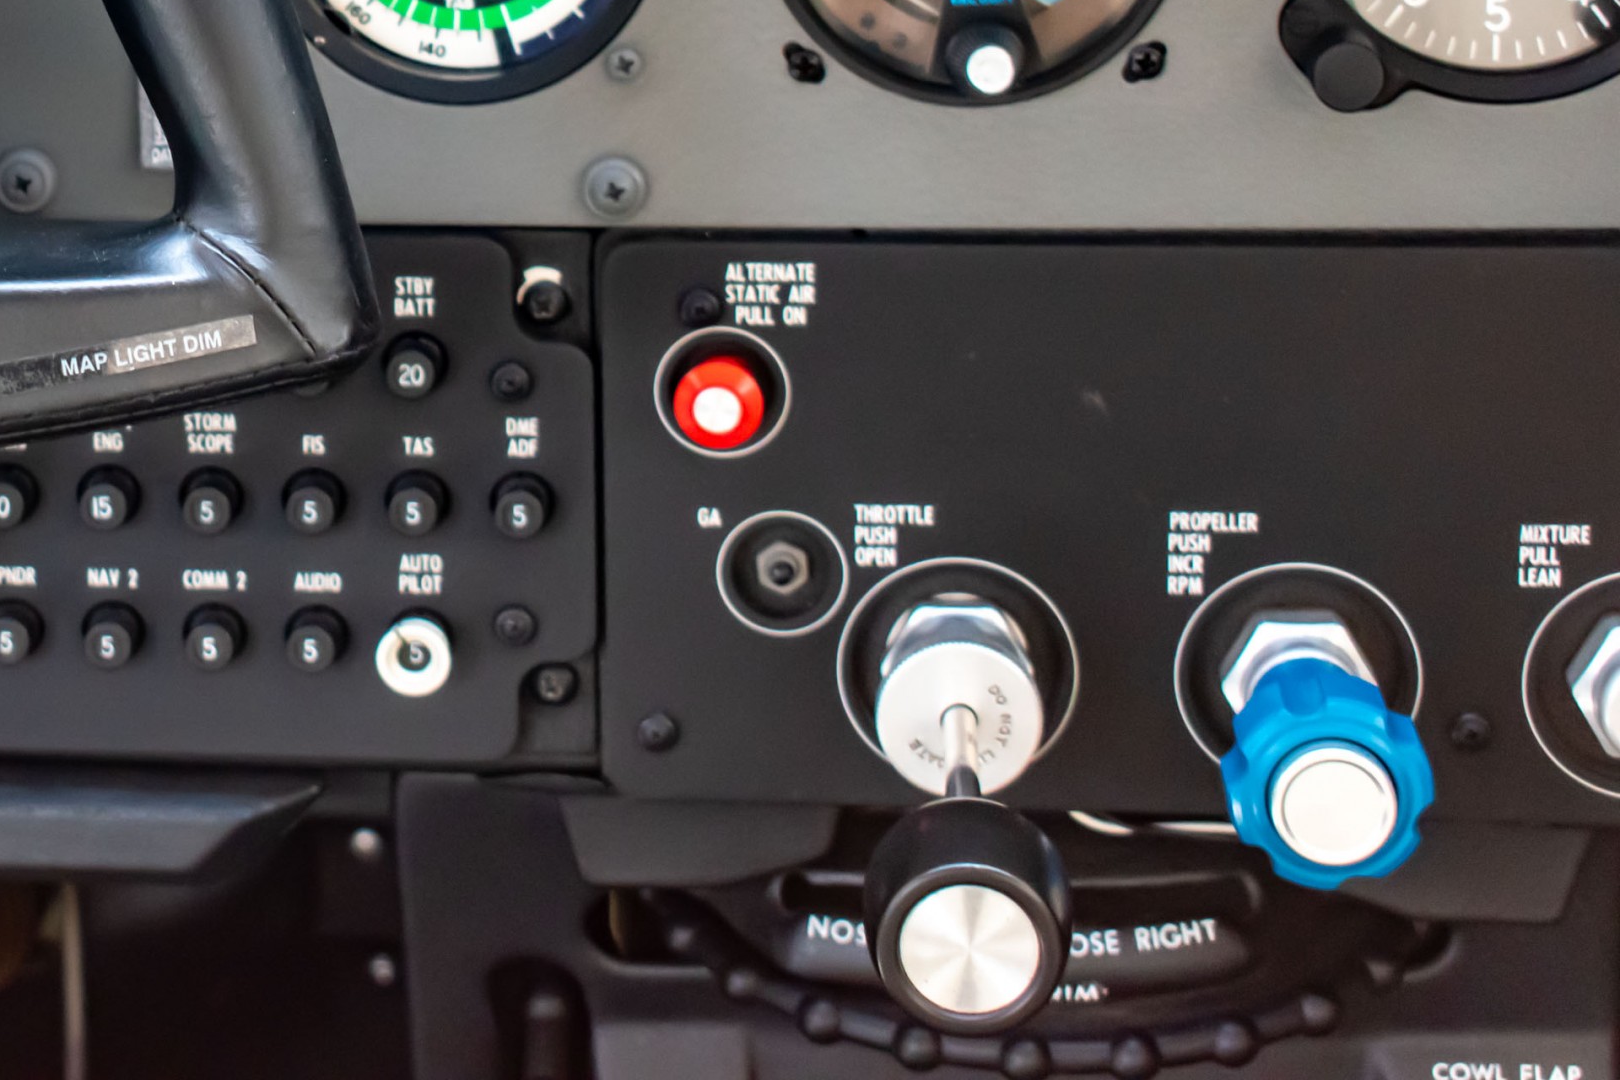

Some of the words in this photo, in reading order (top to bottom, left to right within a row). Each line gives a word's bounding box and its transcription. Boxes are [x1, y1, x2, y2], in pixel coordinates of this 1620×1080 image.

[725, 262, 816, 282] ALTERNATE
[395, 278, 434, 297] STBY
[725, 284, 780, 304] STATIC
[788, 284, 816, 304] AIR
[394, 298, 435, 317] BATT
[734, 306, 775, 326] PULL
[782, 306, 808, 325] ON
[61, 352, 108, 378] MAP
[115, 338, 178, 369] LIGHT
[183, 330, 222, 354] DIM
[398, 365, 425, 386] 20
[183, 414, 237, 433] STORM
[93, 433, 124, 453] ENG
[188, 434, 234, 454] SCOPE
[854, 504, 935, 526] THROTTLE
[1169, 513, 1258, 533] PROPELLER
[854, 526, 898, 546] PUSH
[1520, 525, 1591, 546] MIXTURE
[398, 553, 442, 573] AUTO
[855, 547, 898, 567] OPEN
[87, 568, 120, 588] NAV
[127, 568, 139, 589] 2
[293, 572, 342, 593] AUDIO
[398, 574, 442, 594] PILOT
[1135, 919, 1219, 952] RIGHT
